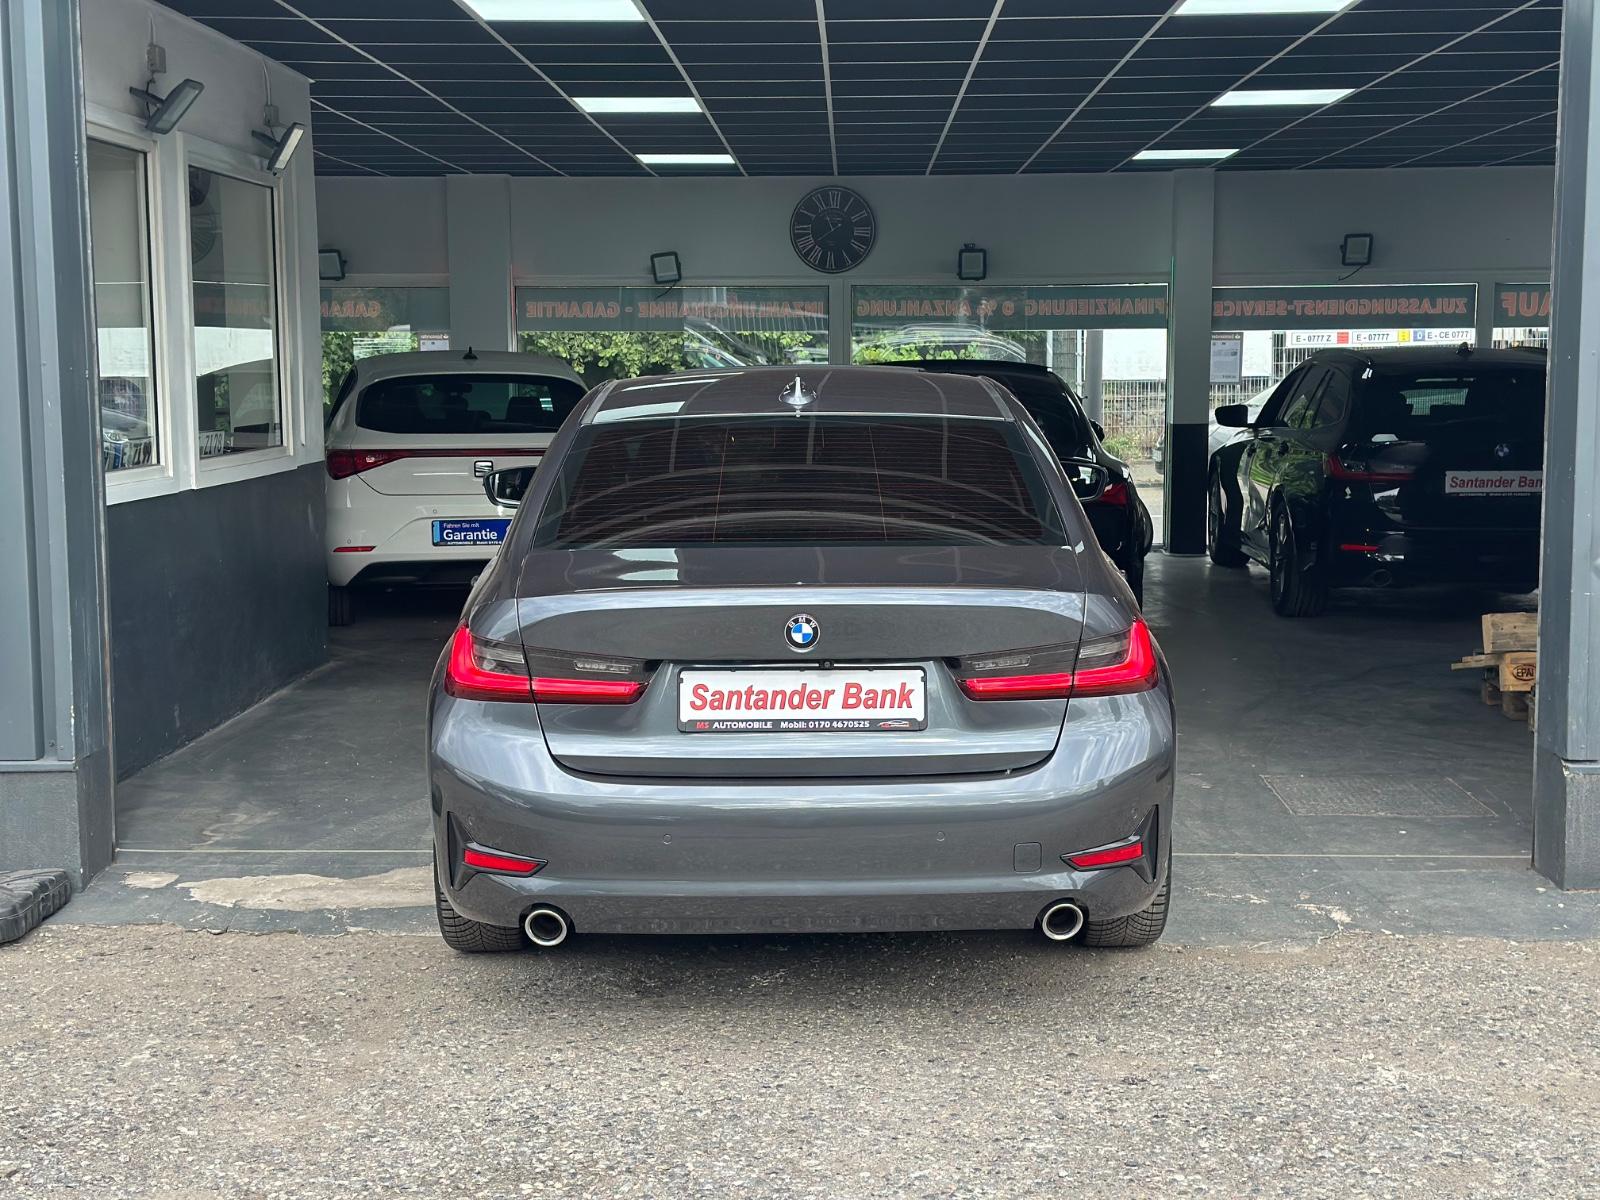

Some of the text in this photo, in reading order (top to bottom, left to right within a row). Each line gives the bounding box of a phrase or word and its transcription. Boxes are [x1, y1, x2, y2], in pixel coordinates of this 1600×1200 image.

[1368, 333, 1390, 341] 07777
[1439, 331, 1450, 339] CE
[1451, 330, 1469, 338] 0777
[1449, 476, 1515, 489] Santander
[443, 529, 498, 541] Garantie
[690, 682, 915, 710] Santander Bank
[696, 721, 870, 730] MS AUTOMOBILE Mobil: 0170 4670525
